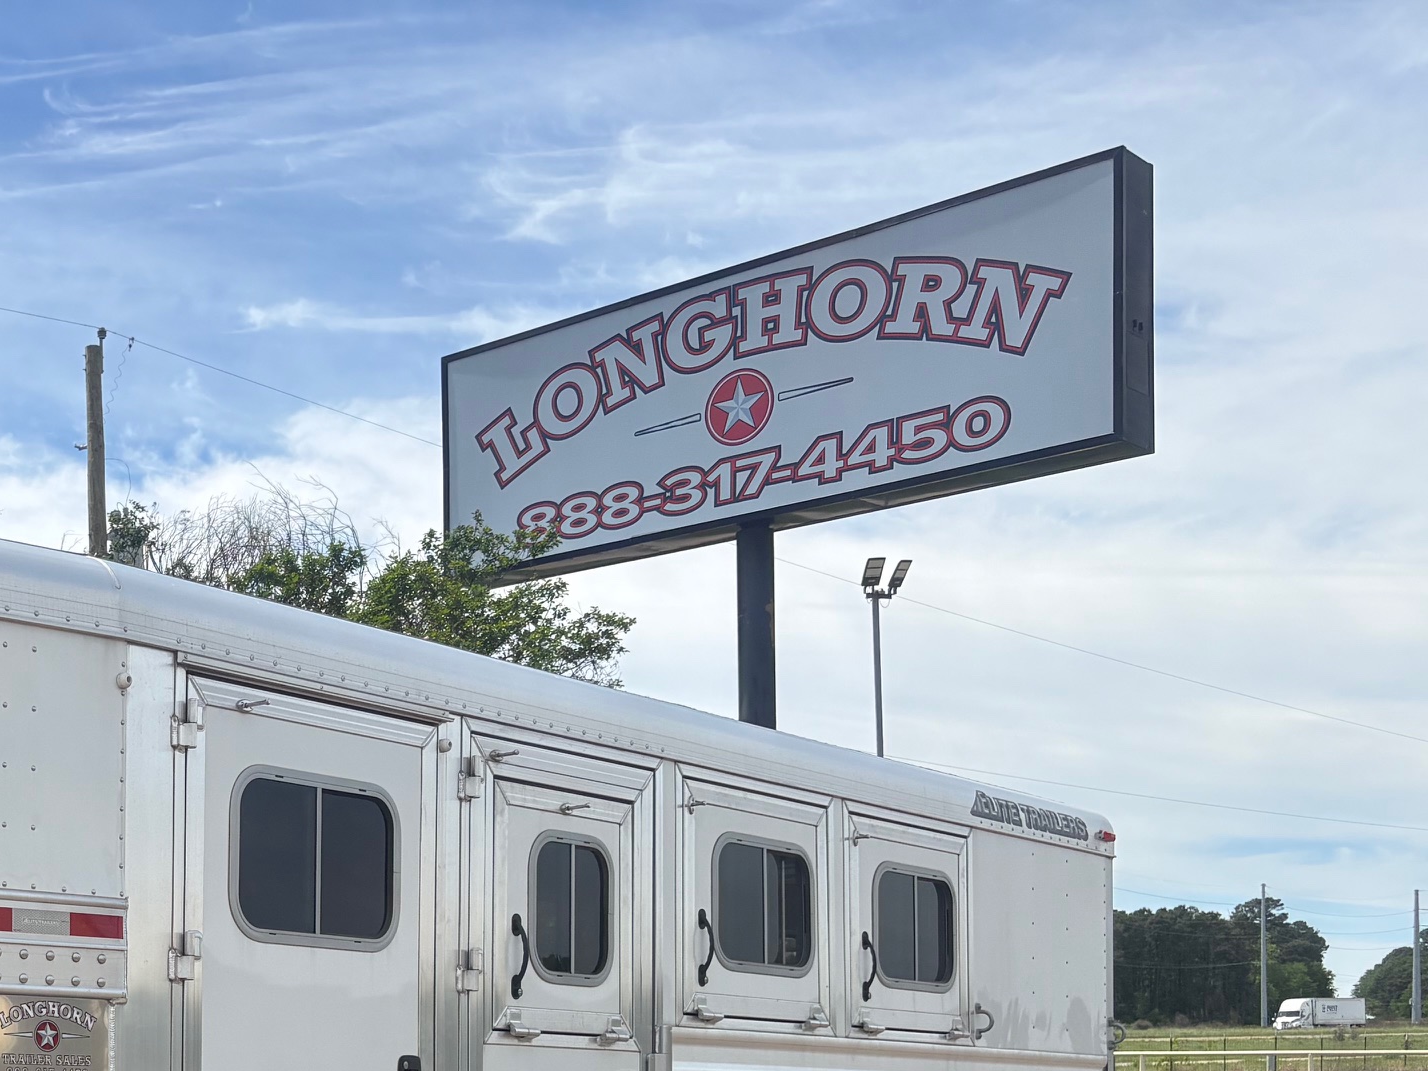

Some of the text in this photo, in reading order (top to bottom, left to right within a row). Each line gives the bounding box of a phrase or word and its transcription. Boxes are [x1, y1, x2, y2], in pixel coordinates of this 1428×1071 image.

[476, 256, 1072, 488] LONGHORN
[517, 396, 1011, 542] 888-317-4450
[970, 790, 1089, 841] ELITE TRAILERS
[2, 1053, 91, 1066] TRAILER SALES
